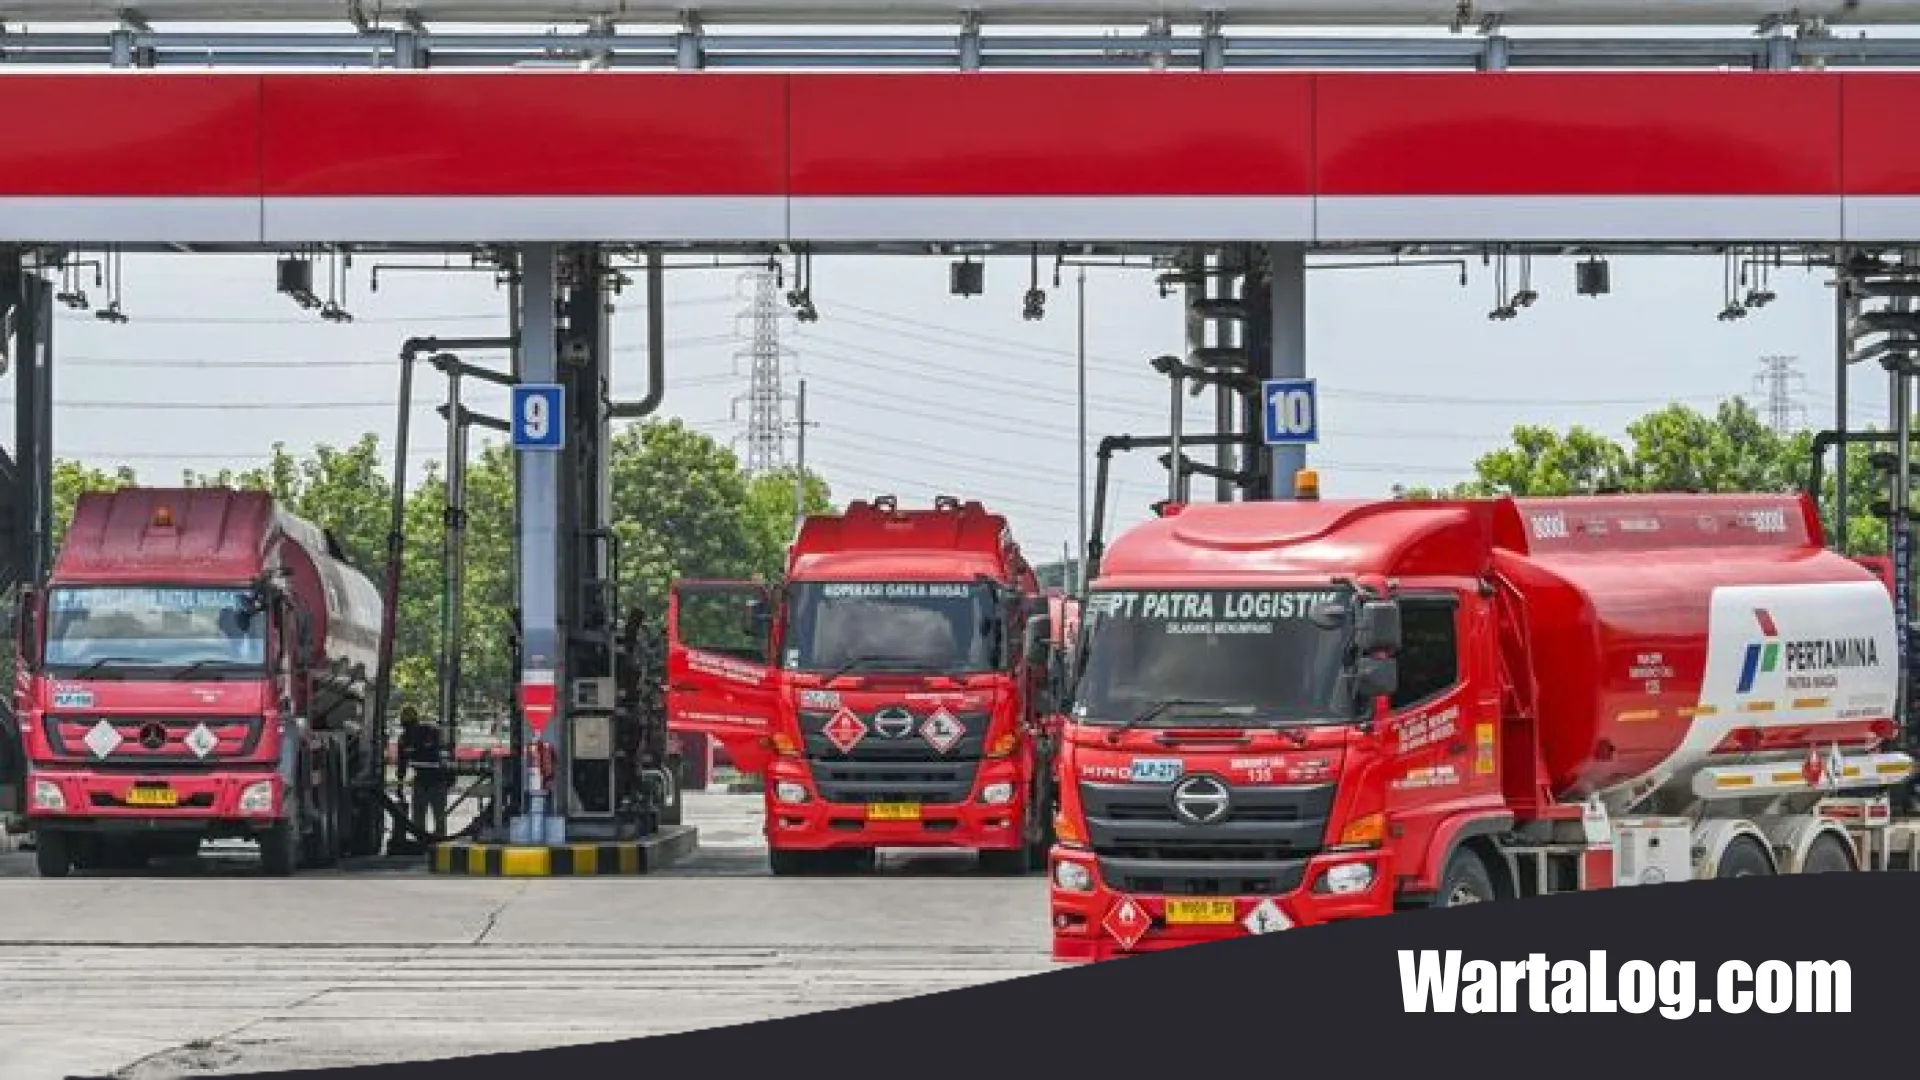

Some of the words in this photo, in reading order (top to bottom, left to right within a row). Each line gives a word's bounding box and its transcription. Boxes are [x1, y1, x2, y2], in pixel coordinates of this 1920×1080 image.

[524, 394, 549, 440] 9
[1270, 391, 1310, 433] 10
[1107, 592, 1139, 618] PT
[1143, 592, 1213, 618] PATRA
[1785, 636, 1880, 671] PERTAMINA
[1082, 765, 1131, 780] HINO
